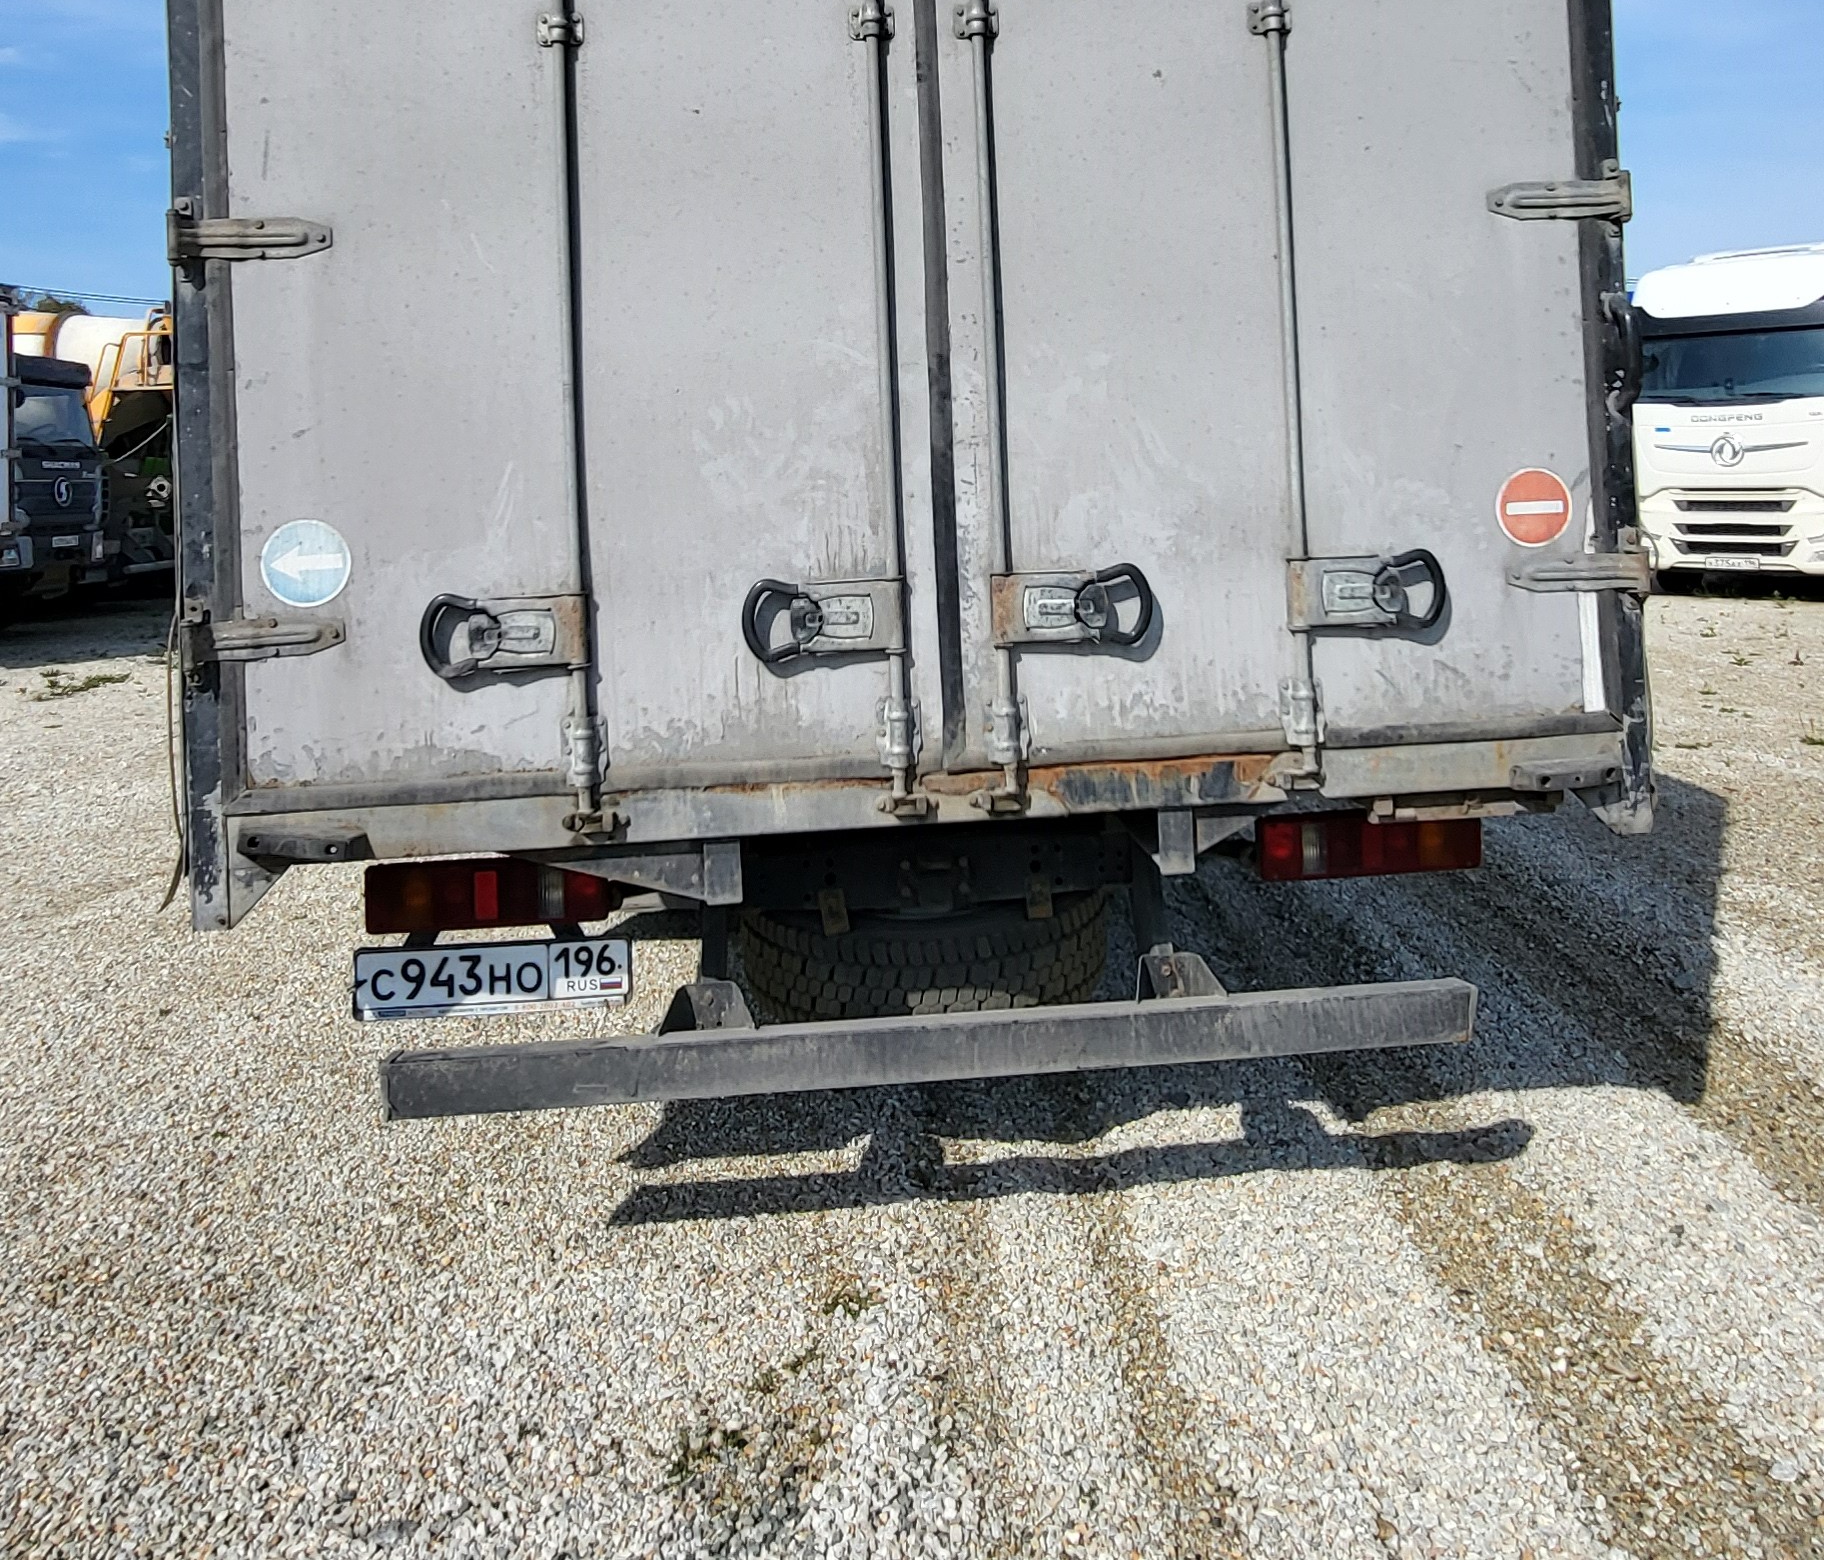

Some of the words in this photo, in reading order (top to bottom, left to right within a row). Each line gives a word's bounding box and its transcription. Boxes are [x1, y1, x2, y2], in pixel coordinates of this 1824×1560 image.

[1690, 413, 1764, 423] DONGFENG
[370, 955, 543, 1001] C943HO
[554, 943, 617, 979] 196
[566, 978, 598, 993] RUS
